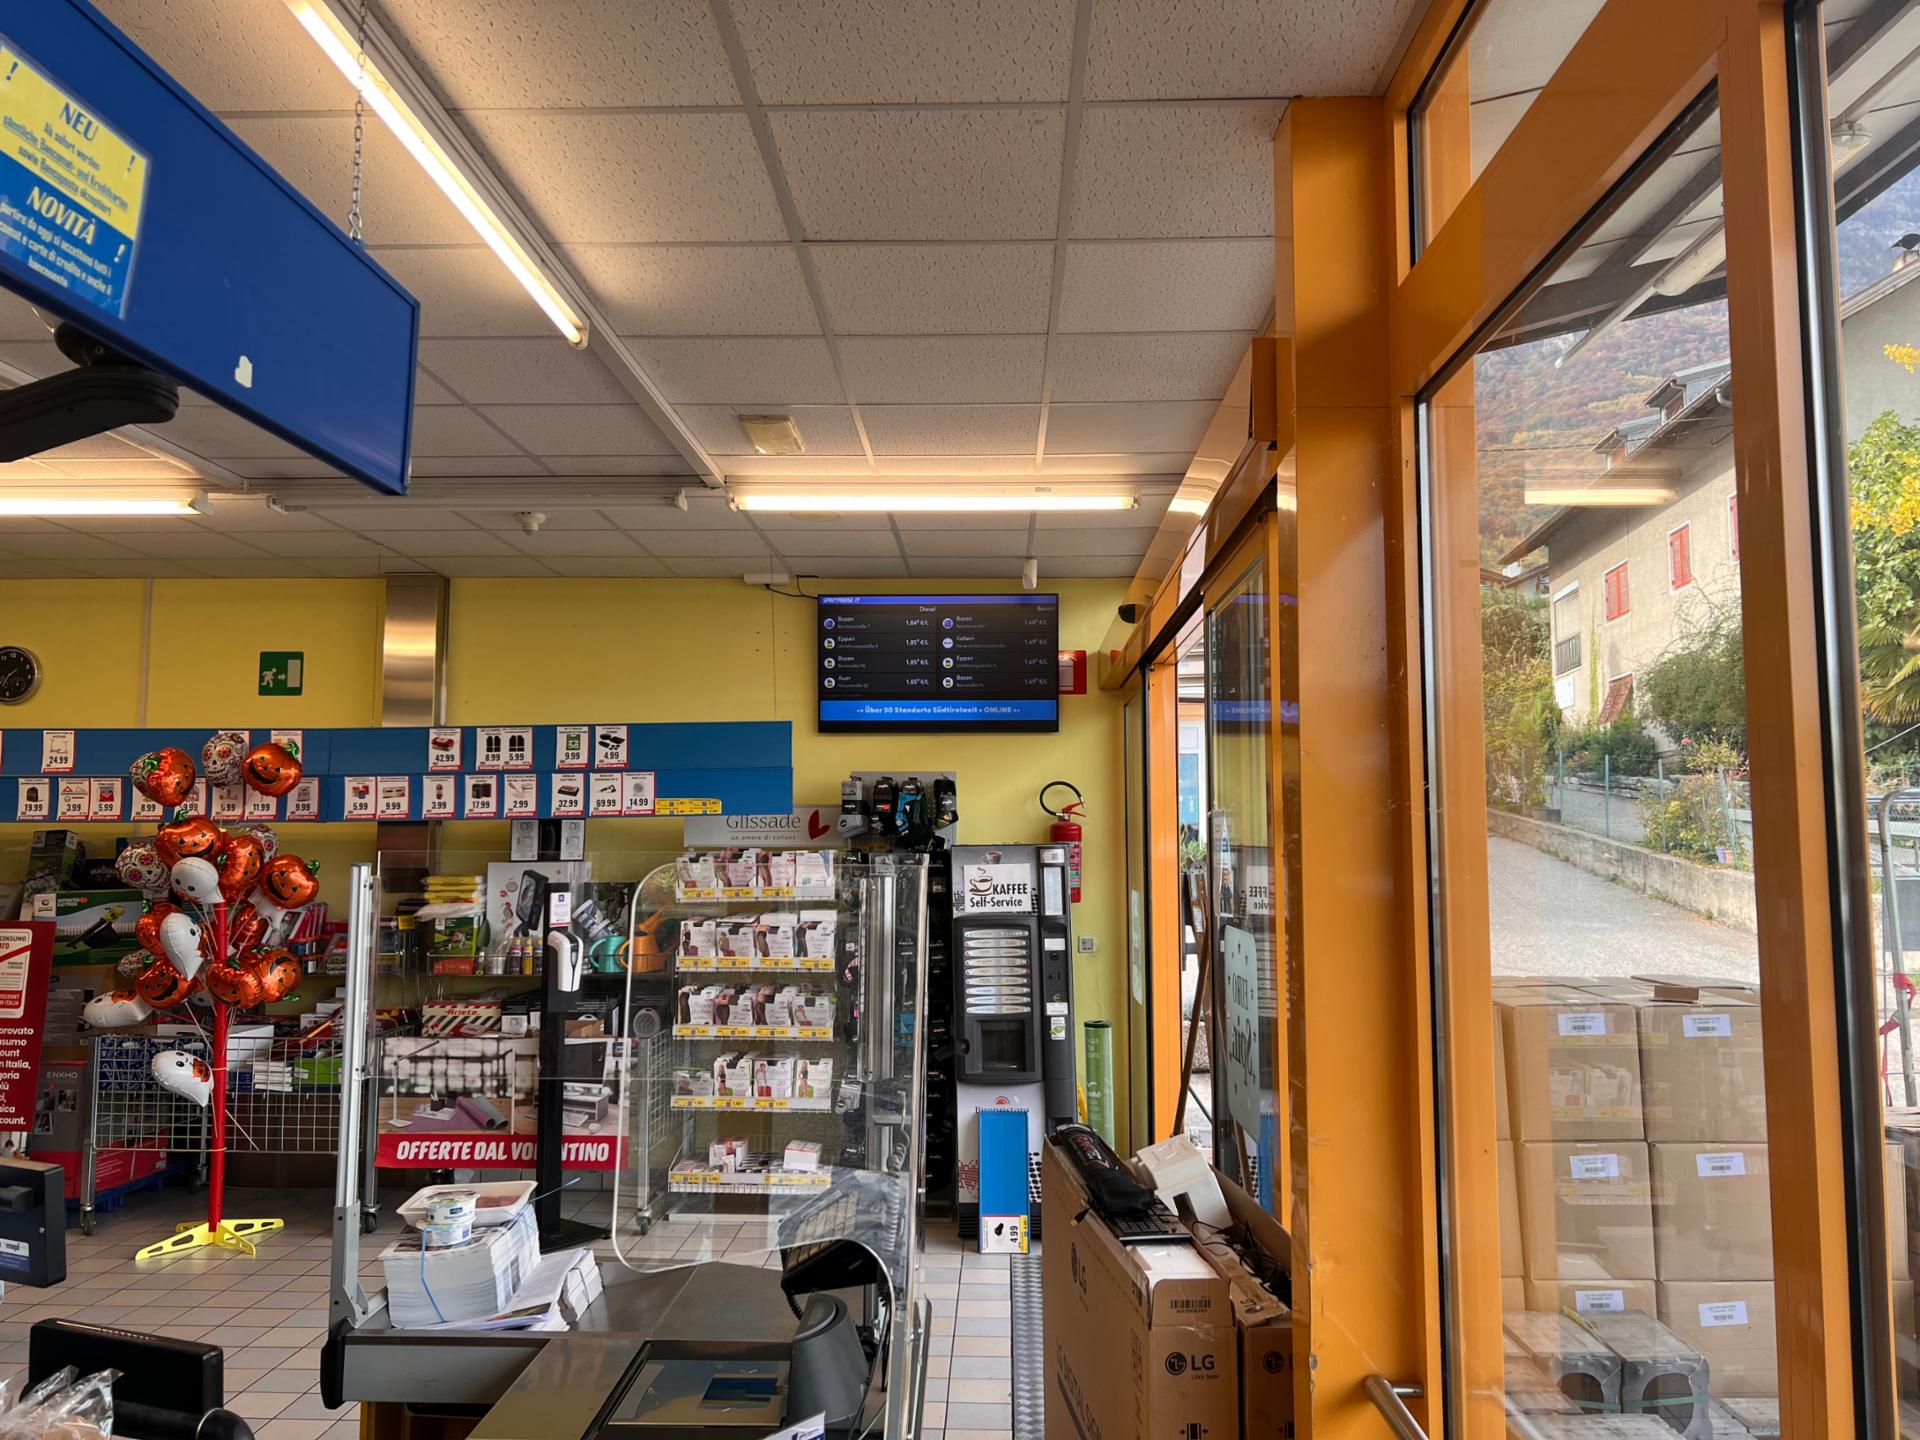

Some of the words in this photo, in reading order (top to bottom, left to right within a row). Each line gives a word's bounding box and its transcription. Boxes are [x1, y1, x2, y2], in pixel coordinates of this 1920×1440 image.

[60, 102, 99, 141] NEU
[26, 186, 96, 245] NOVITÀ
[865, 705, 882, 713] Über
[49, 756, 68, 764] 24.99
[435, 754, 455, 762] 42.99
[485, 753, 500, 761] 8.99
[508, 753, 525, 761] 5.99
[564, 752, 580, 760] 9.99
[604, 751, 619, 760] 4.99
[353, 802, 368, 811] 5.99
[385, 802, 401, 810] 9.99
[431, 801, 447, 809] 3.99
[472, 801, 490, 809] 17.99
[513, 800, 528, 808] 2.99
[558, 799, 578, 808] 32.99
[596, 799, 616, 808] 69.99
[629, 798, 648, 807] 14.99
[24, 803, 43, 812] 19.99
[66, 803, 81, 812] 3.99
[98, 803, 113, 812] 5.99
[140, 803, 156, 812] 8.99
[252, 803, 270, 812] 11.99
[295, 803, 311, 812] 9.99
[726, 814, 801, 829] Glissade
[993, 883, 1028, 895] KAFFEE
[970, 896, 1023, 908] Self-Service
[6, 1060, 31, 1070] Italia,
[47, 1071, 78, 1079] ENKHO
[396, 1140, 472, 1160] OFFERTE
[474, 1141, 507, 1160] DAL
[1010, 1225, 1018, 1243] 4.99
[1191, 1354, 1215, 1371] LG
